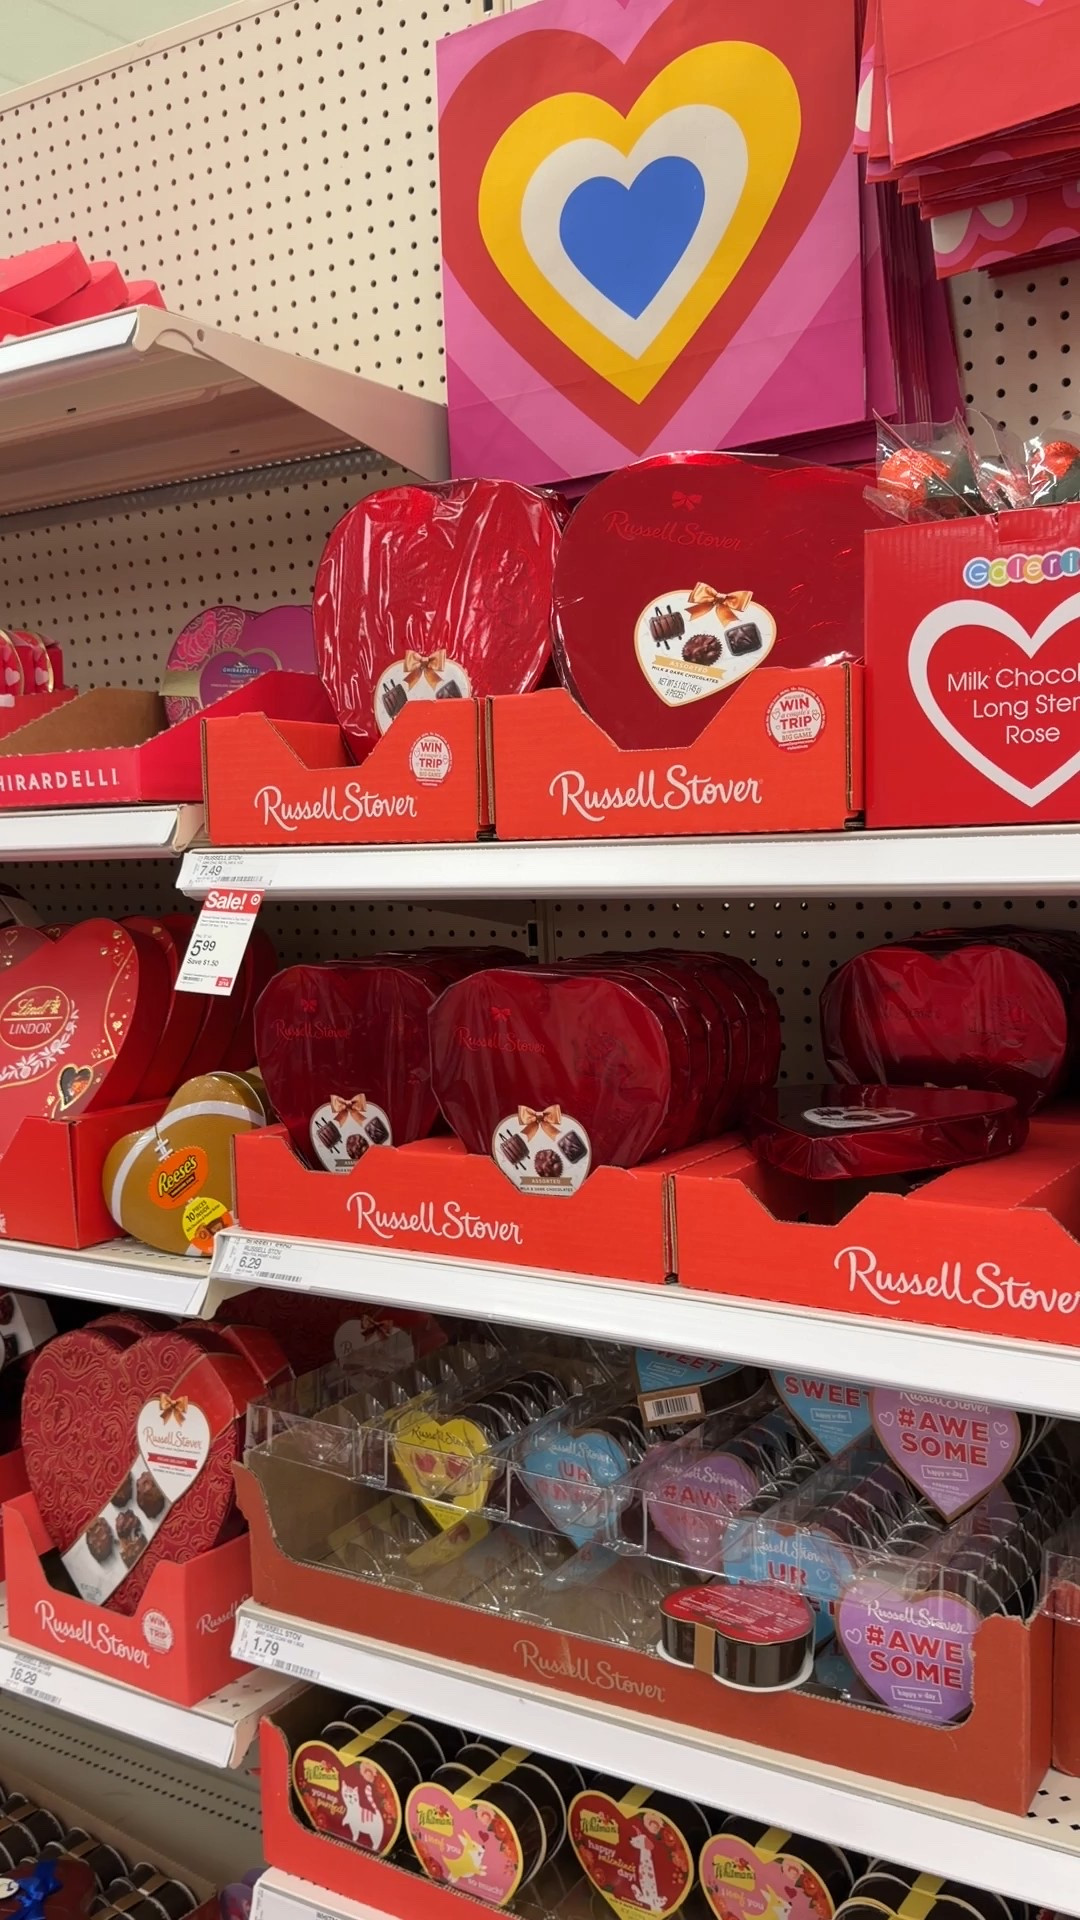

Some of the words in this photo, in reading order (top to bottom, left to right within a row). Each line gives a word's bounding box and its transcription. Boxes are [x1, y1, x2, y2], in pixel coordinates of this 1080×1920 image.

[603, 510, 677, 542] Russell
[676, 523, 742, 551] Stover
[669, 661, 708, 673] ASSORTED
[684, 673, 719, 684] CHOCOLATES
[947, 672, 989, 692] Milk
[780, 697, 810, 711] WIN
[973, 699, 1029, 721] Long
[780, 715, 812, 730] TRIP
[794, 731, 813, 739] GAME
[1006, 726, 1061, 745] Rose
[420, 742, 442, 752] WIN
[419, 758, 443, 768] TRIP
[549, 770, 664, 822] Russell
[663, 764, 762, 811] Stover
[254, 785, 343, 831] Russell
[342, 782, 417, 822] Stover
[200, 865, 223, 876] 7.49
[205, 891, 248, 911] Sale!
[187, 957, 202, 965] Save
[203, 959, 220, 967] $1.50
[11, 998, 51, 1017] Lindt
[9, 1022, 52, 1035] LINDOR
[270, 1019, 313, 1041] Russell
[503, 1032, 546, 1053] Stover
[158, 1155, 198, 1197] Reese's
[185, 1212, 196, 1223] 10
[192, 1200, 208, 1214] PIECES
[195, 1205, 210, 1219] INSIDE
[346, 1191, 443, 1239] Russell
[442, 1201, 523, 1245] Stover
[239, 1256, 262, 1270] 6.29
[833, 1246, 973, 1305] Russell
[898, 1407, 990, 1444] #AWE
[143, 1426, 175, 1448] Russell
[175, 1431, 202, 1449] Stover
[900, 1432, 989, 1469] SOME
[926, 1468, 945, 1478] happy
[767, 1560, 808, 1586] UR
[149, 1615, 166, 1628] WIN
[866, 1600, 919, 1626] Russell
[918, 1608, 963, 1634] Stover
[35, 1600, 98, 1649] Russell
[96, 1623, 150, 1669] Stover
[150, 1628, 168, 1639] TRIP
[255, 1623, 285, 1636] RUSSELL
[284, 1630, 303, 1641] STOV
[253, 1637, 280, 1656] 1.79
[865, 1624, 965, 1665] #AWE
[10, 1667, 38, 1686] 16.29
[513, 1639, 597, 1684] Russell
[595, 1661, 666, 1703] Stover
[869, 1650, 964, 1690] SOME
[896, 1689, 917, 1699] happy
[312, 1789, 326, 1798] you
[326, 1793, 338, 1802] are
[446, 1843, 462, 1855] you
[587, 1840, 616, 1857] happy
[467, 1878, 478, 1887] so
[617, 1868, 637, 1882] day!
[746, 1898, 765, 1910] you
